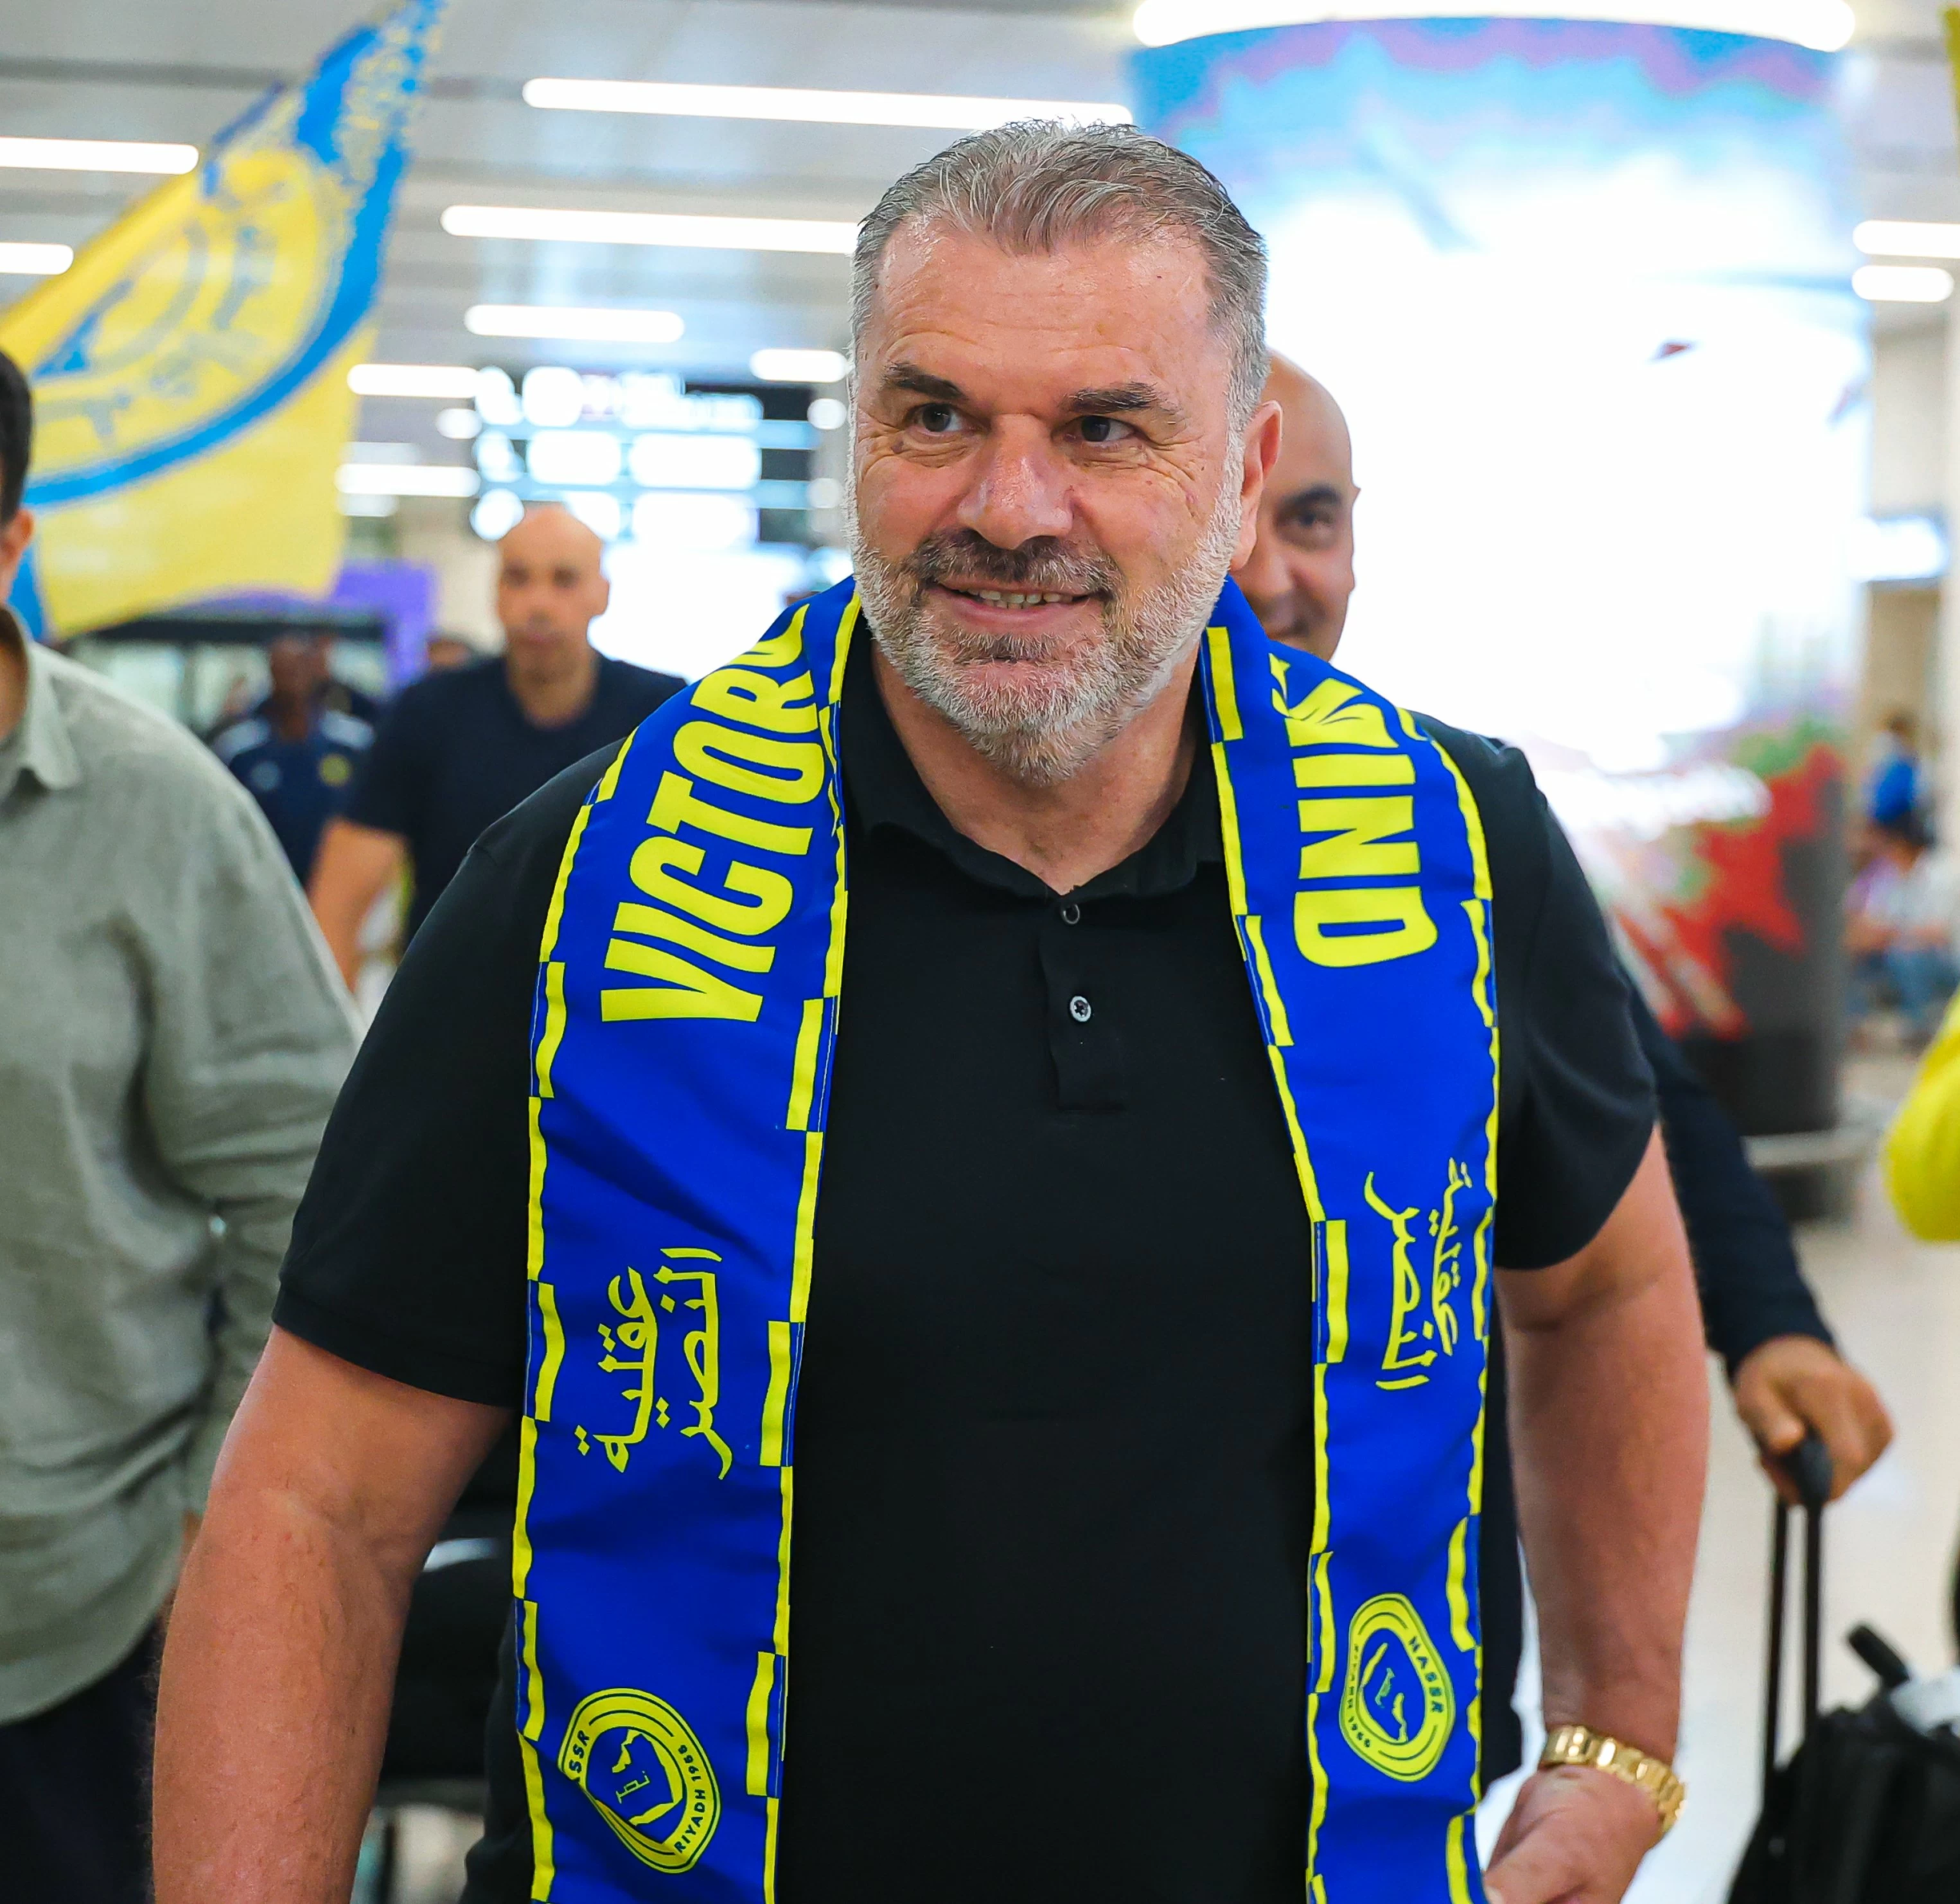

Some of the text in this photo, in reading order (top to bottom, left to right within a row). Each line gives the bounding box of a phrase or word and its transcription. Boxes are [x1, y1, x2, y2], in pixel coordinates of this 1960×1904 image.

[1364, 1171, 1437, 1390] النصر
[1429, 1157, 1472, 1357] عقلية
[574, 1266, 671, 1473] عقلية
[653, 1247, 733, 1480] النصر
[675, 1789, 706, 1853] RIYADH
